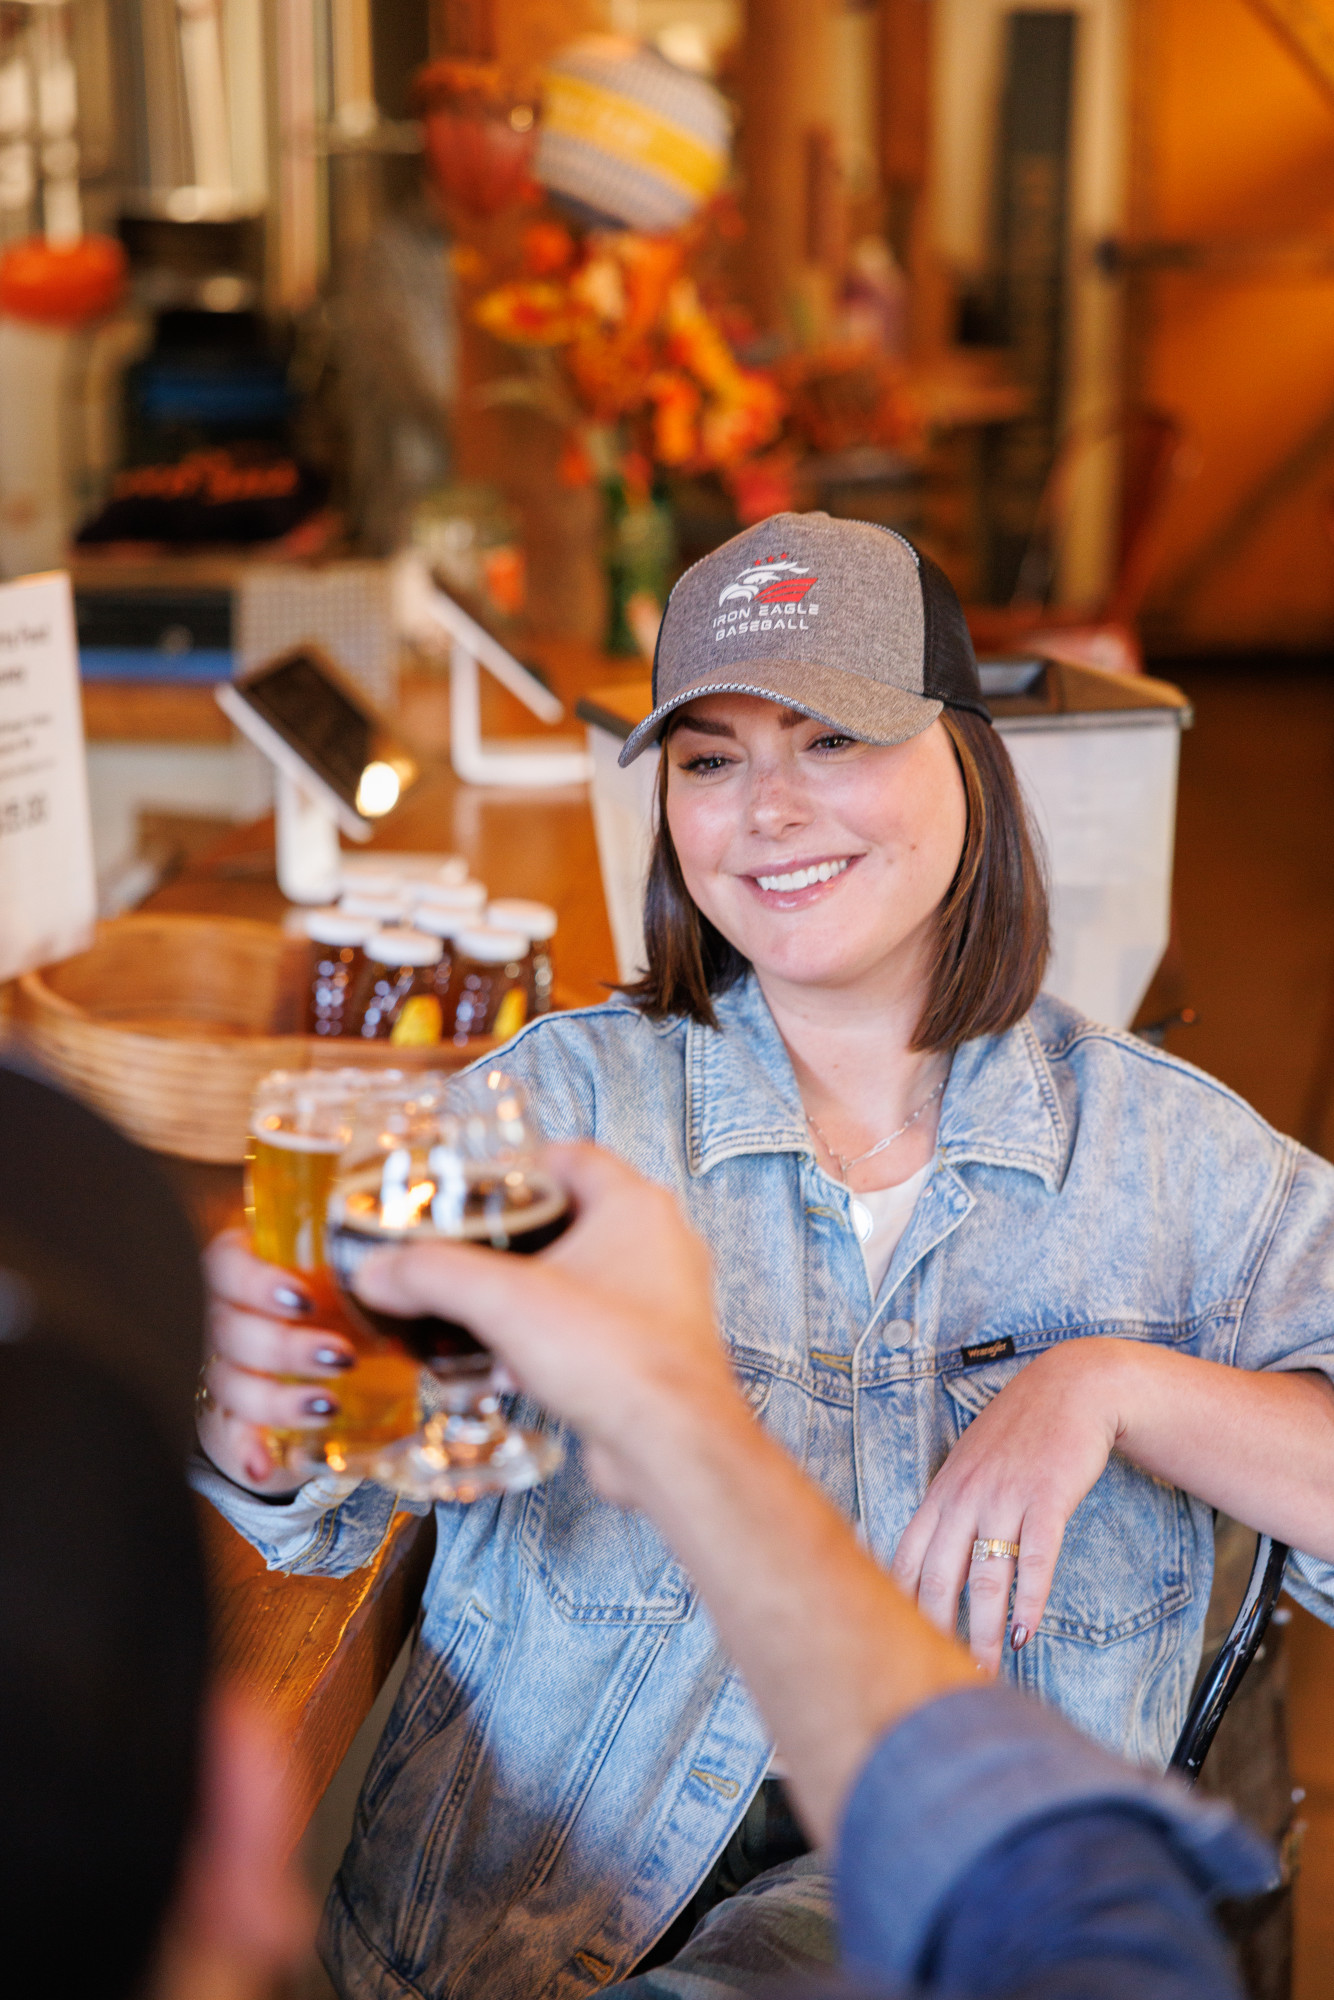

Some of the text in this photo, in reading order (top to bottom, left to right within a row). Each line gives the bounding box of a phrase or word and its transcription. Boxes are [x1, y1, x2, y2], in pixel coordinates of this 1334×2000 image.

[712, 603, 819, 629] IRON EAGLE
[715, 618, 809, 642] BASEBALL
